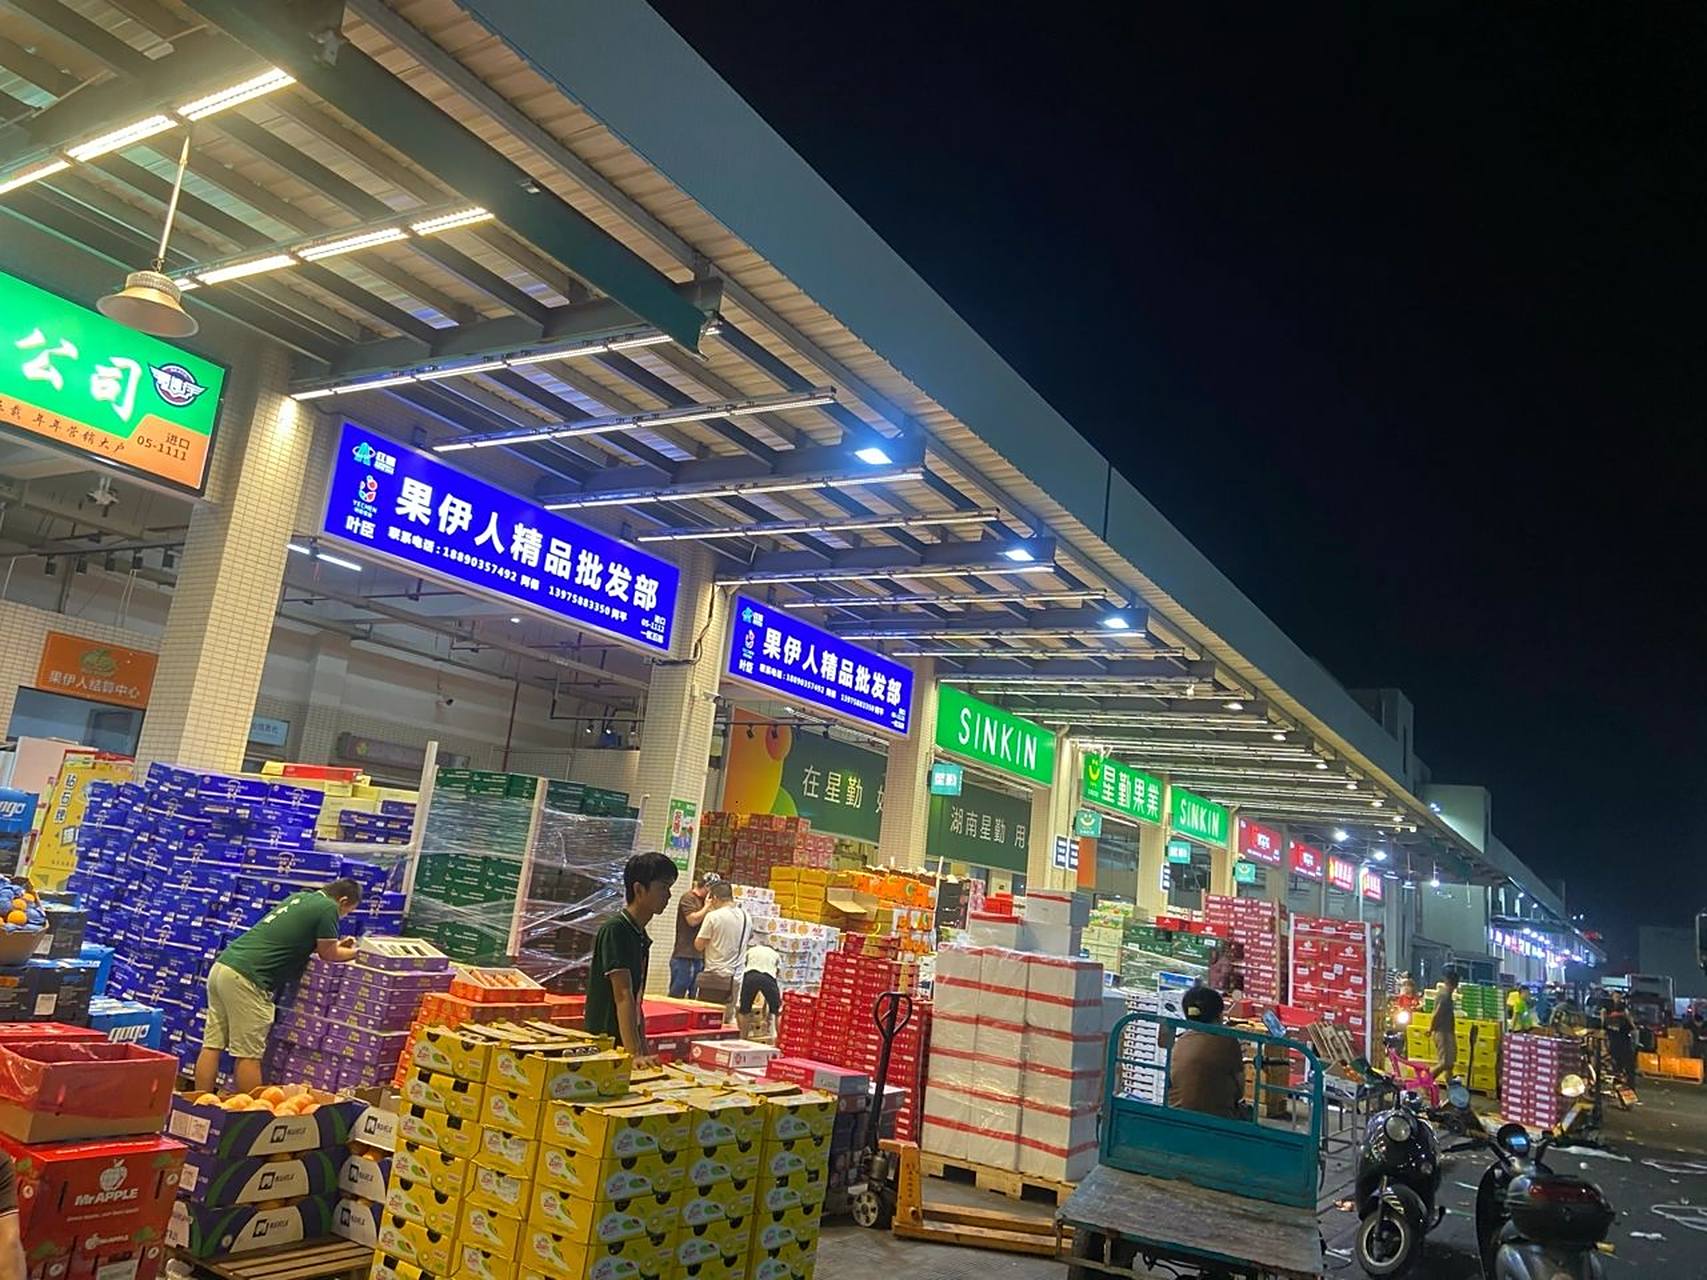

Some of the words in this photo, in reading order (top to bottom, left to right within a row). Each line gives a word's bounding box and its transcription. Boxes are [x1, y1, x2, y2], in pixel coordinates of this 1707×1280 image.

[15, 327, 142, 422] 公司
[136, 434, 187, 461] 05-1111
[165, 432, 191, 451] 进口
[345, 514, 377, 540] 叶臣
[395, 476, 660, 611] 果伊人精品批发部
[763, 627, 902, 706] 果伊人精品批发部
[958, 707, 1038, 771] SINKIN
[802, 764, 864, 809] 在星勤
[950, 804, 1006, 844] 湖南星勤
[1014, 824, 1026, 849] 用
[1179, 799, 1220, 838] SINKIN
